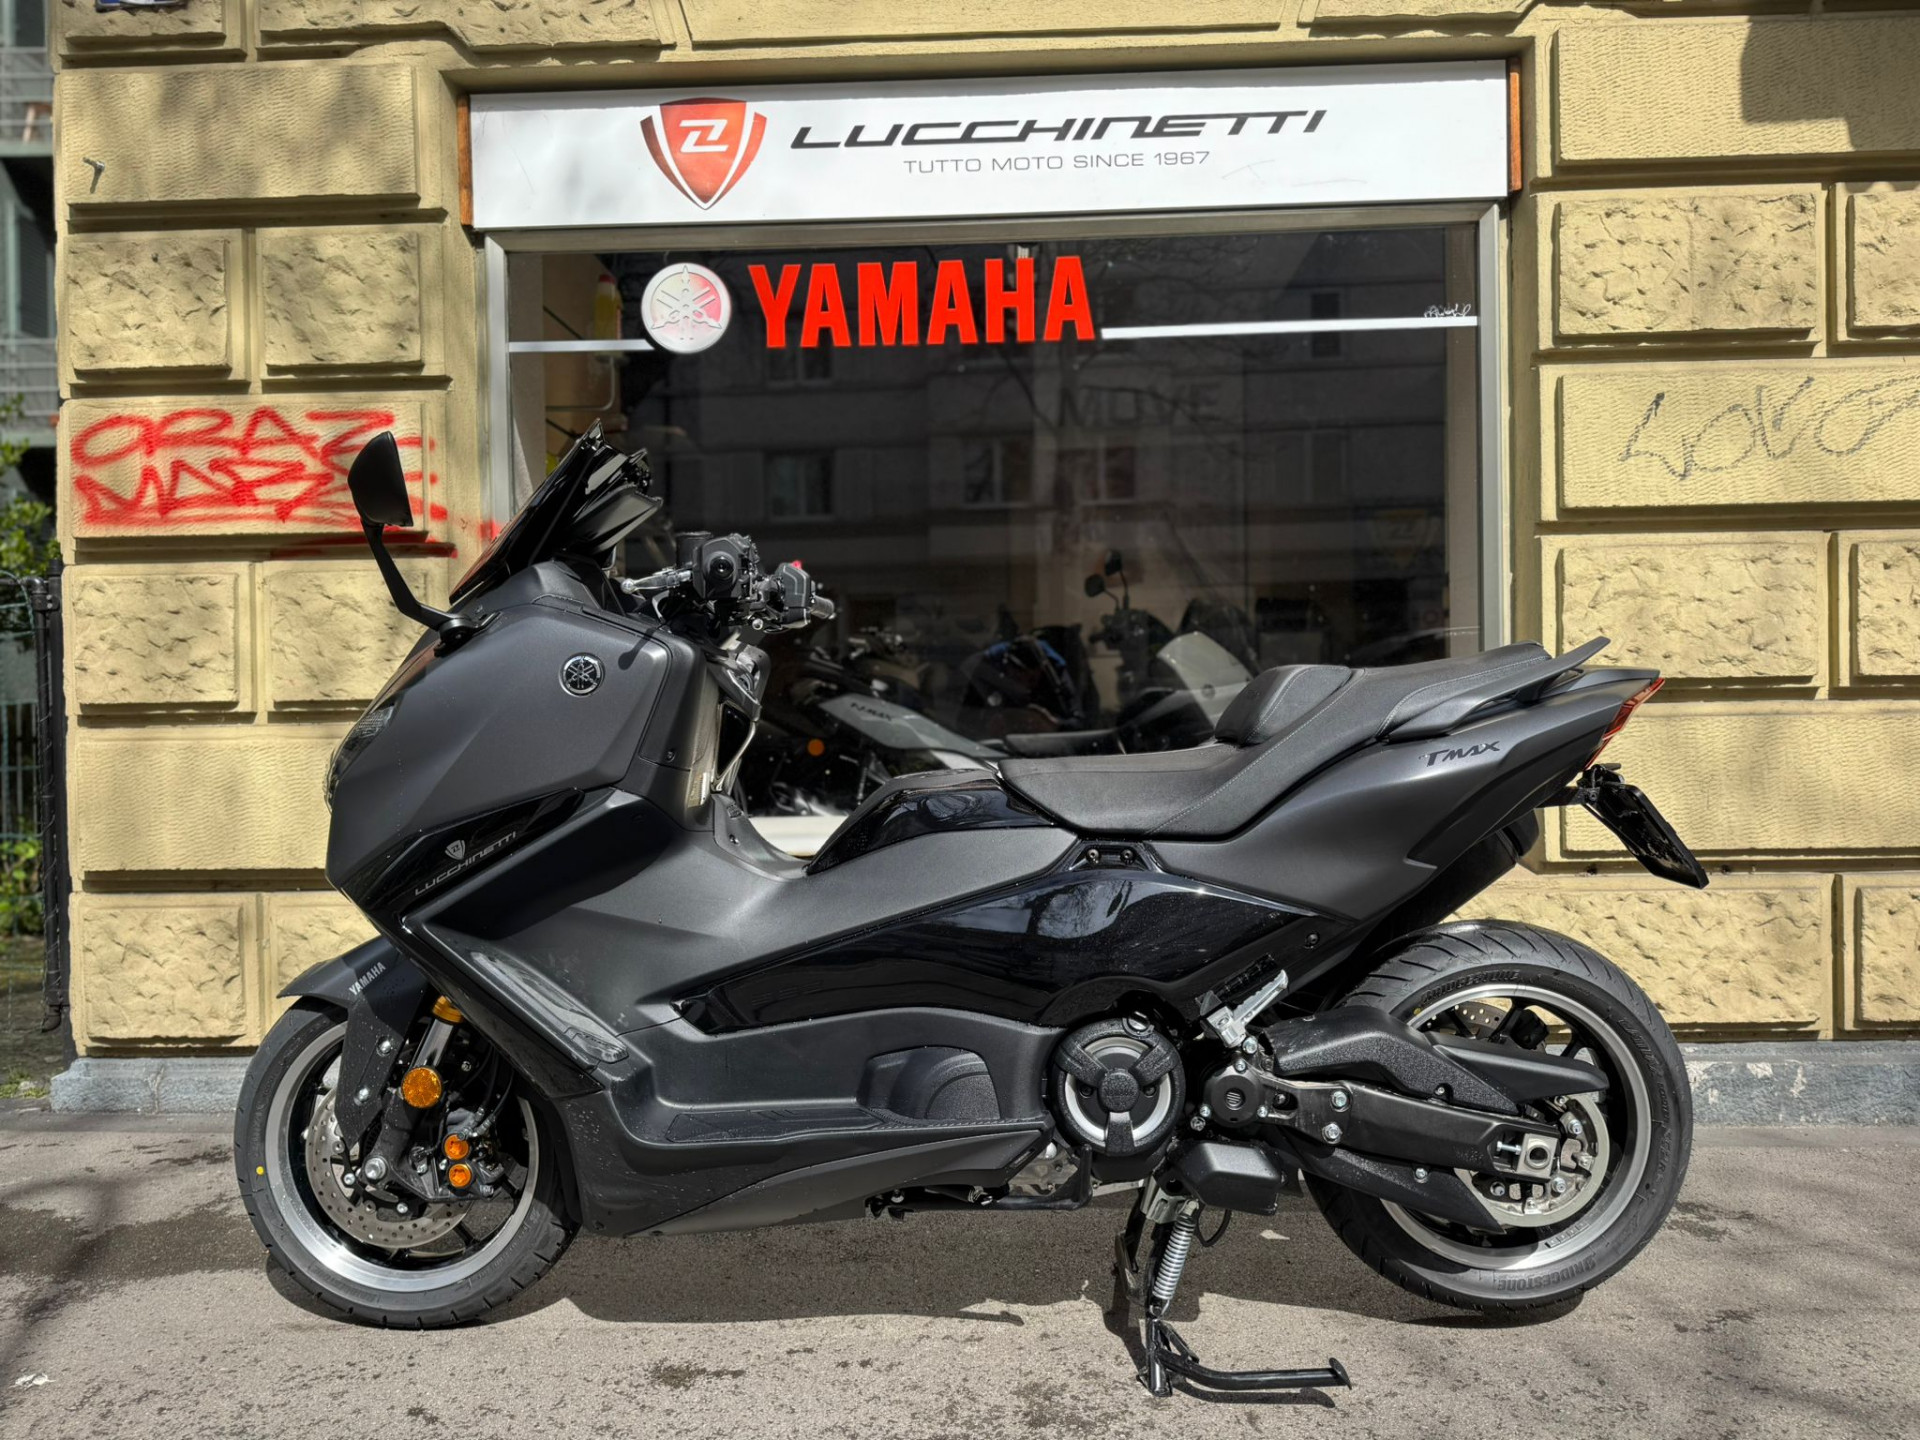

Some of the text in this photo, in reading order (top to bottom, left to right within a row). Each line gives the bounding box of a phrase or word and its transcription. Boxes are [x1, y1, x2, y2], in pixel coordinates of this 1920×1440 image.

[790, 110, 1327, 149] LUCCHINETTI
[903, 150, 1211, 174] TUTTO MOTO SINCE 1967
[748, 255, 1095, 348] YAMAHA
[1418, 741, 1501, 768] TMAX
[414, 830, 517, 896] LUCCHINETTI
[348, 961, 387, 996] YAMAHA
